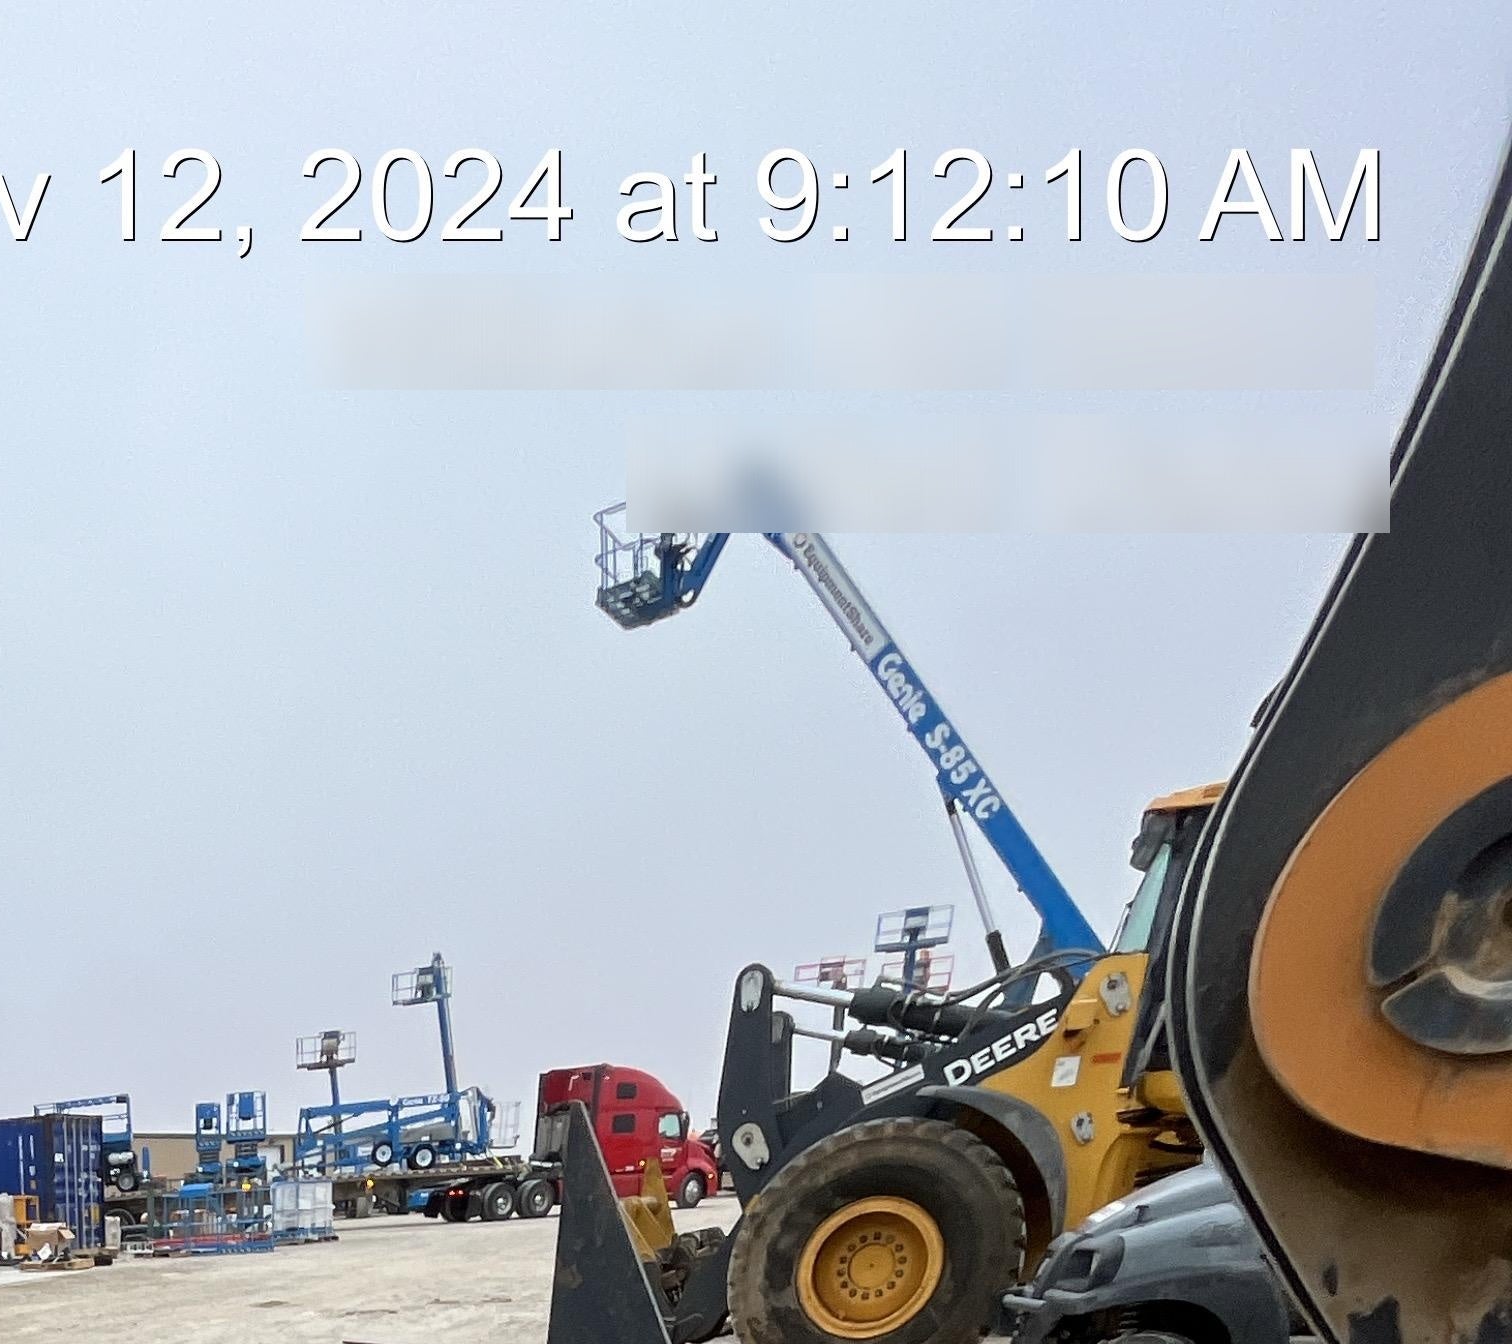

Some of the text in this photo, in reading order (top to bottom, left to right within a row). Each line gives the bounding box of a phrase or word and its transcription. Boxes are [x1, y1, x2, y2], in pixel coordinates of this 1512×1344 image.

[877, 652, 1002, 820] Genie S-85 XC
[942, 1008, 1059, 1088] DEERE
